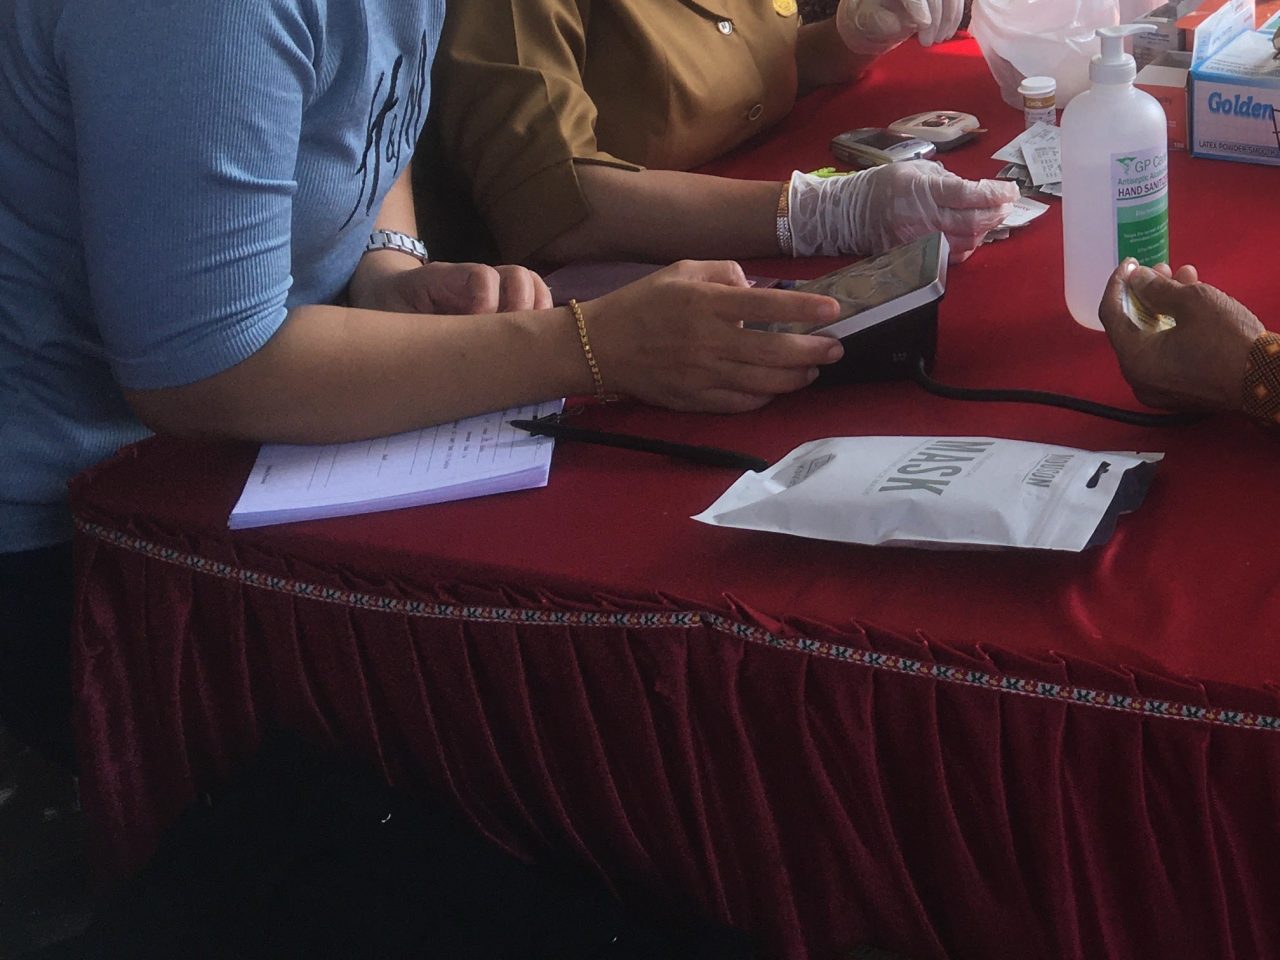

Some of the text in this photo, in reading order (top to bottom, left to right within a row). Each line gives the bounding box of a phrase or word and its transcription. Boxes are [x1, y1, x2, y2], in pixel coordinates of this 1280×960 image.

[1207, 91, 1274, 121] Golden
[1199, 140, 1217, 149] LATEX
[1134, 159, 1152, 173] GP
[1117, 185, 1143, 197] HAND
[878, 440, 996, 497] MASK
